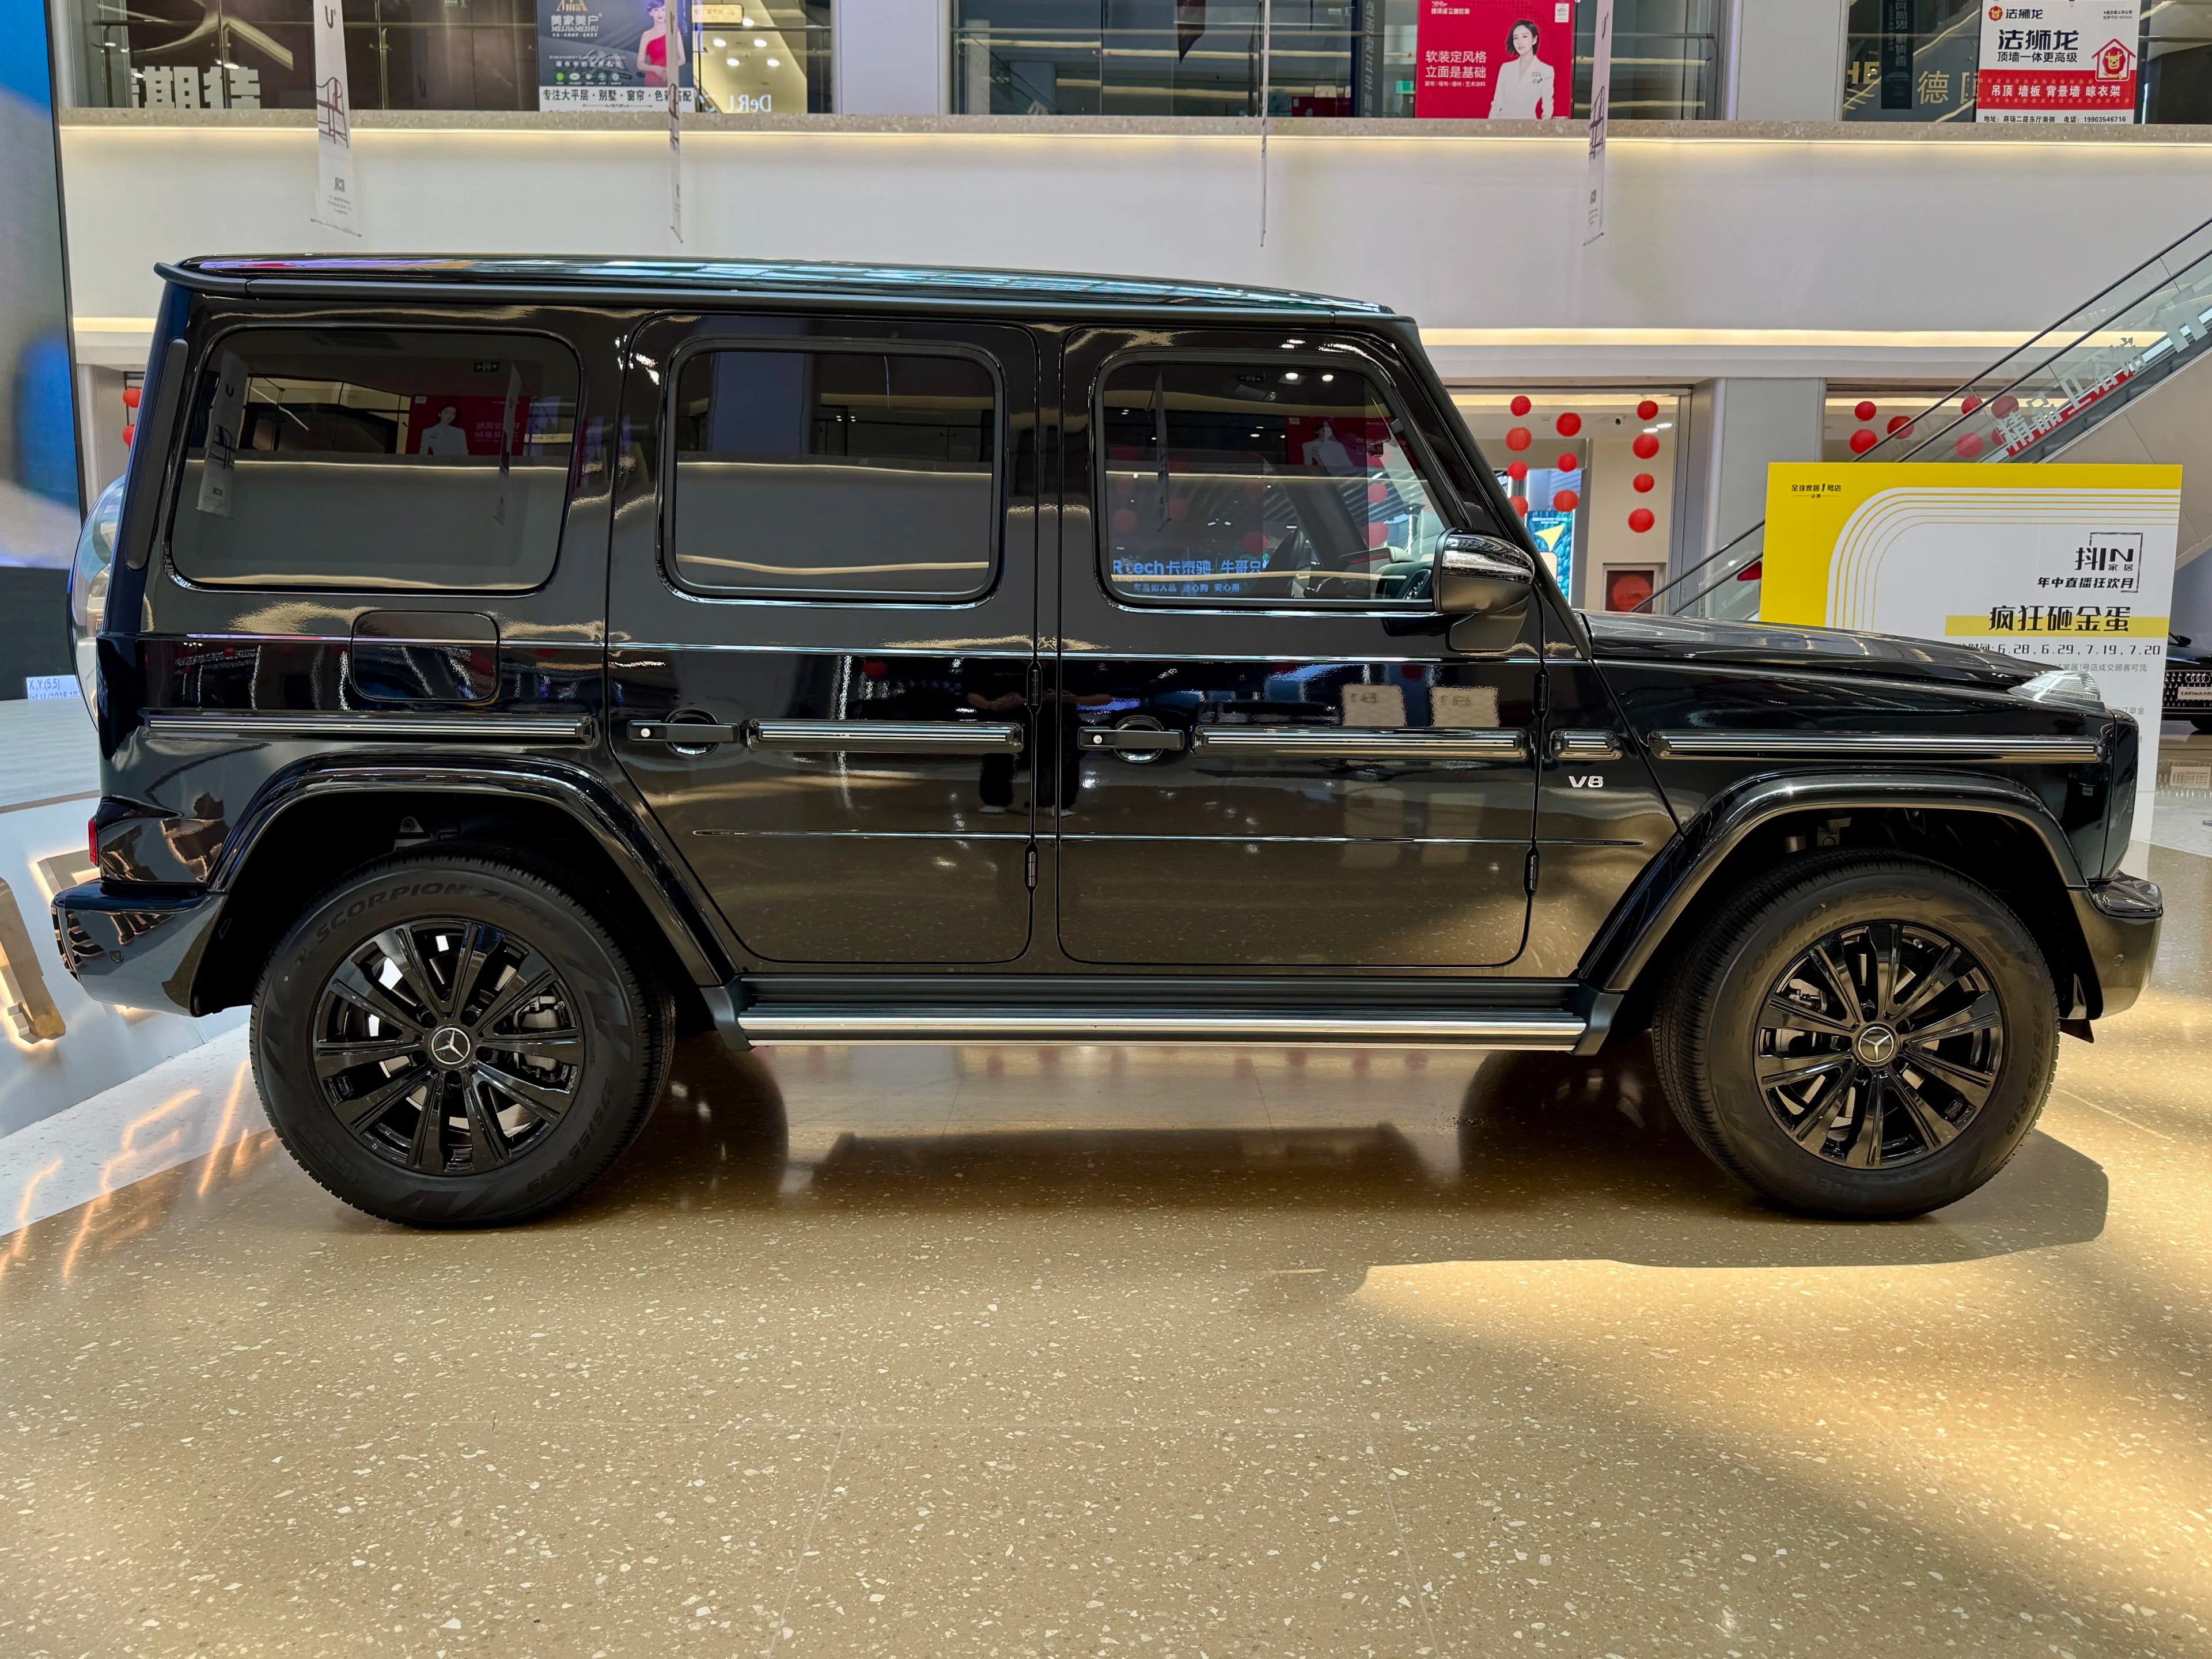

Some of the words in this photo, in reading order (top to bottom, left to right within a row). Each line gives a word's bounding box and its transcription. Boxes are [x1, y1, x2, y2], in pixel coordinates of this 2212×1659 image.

[551, 14, 599, 26] 美家美户
[2006, 9, 2043, 20] 法狮龙
[1998, 29, 2079, 50] 法狮龙
[1425, 50, 1487, 63] 软装定风格
[1997, 51, 2078, 63] 顶墙一体更高级
[1425, 66, 1486, 78] 立面是基础
[1991, 85, 2013, 97] 吊顶
[2018, 85, 2040, 97] 墙板
[2046, 85, 2081, 97] 背景墙
[2085, 85, 2121, 97] 晾衣架
[1791, 483, 1842, 492] 全球家居1号店
[2037, 577, 2134, 588] 年中直播狂欢月
[1988, 605, 2131, 632] 疯狂砸金蛋
[1568, 775, 1604, 788] V8
[1852, 888, 1935, 903] ZERO
[316, 882, 467, 946] SCORPION
